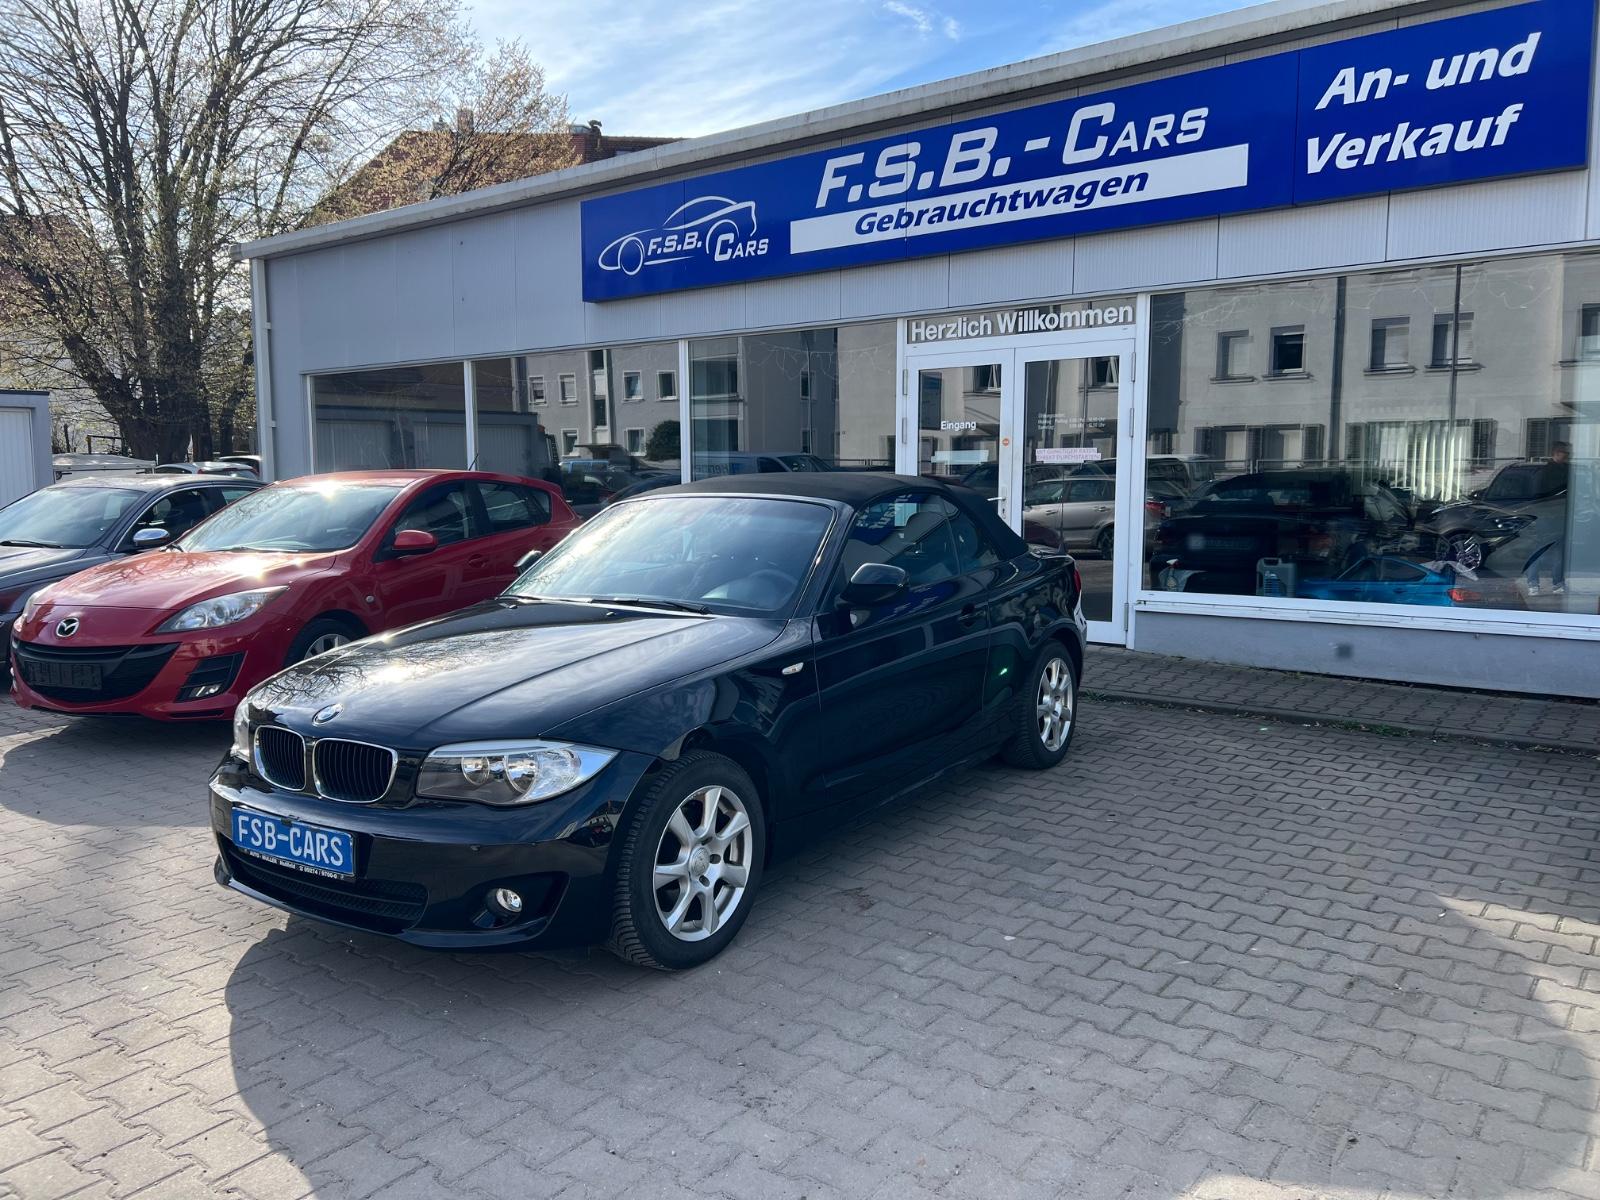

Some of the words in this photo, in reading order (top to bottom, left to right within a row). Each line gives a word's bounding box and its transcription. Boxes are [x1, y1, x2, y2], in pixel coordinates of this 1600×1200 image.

[1315, 67, 1409, 110] An-
[1426, 32, 1541, 90] und
[1307, 104, 1523, 174] Verkauf
[855, 171, 1149, 235] Gebrauchtwagen
[647, 231, 702, 256] F.S.B.
[911, 315, 991, 341] Herzlich
[997, 306, 1133, 334] Willkommen
[940, 420, 976, 431] Eingang
[238, 815, 344, 867] FSB-CARS
